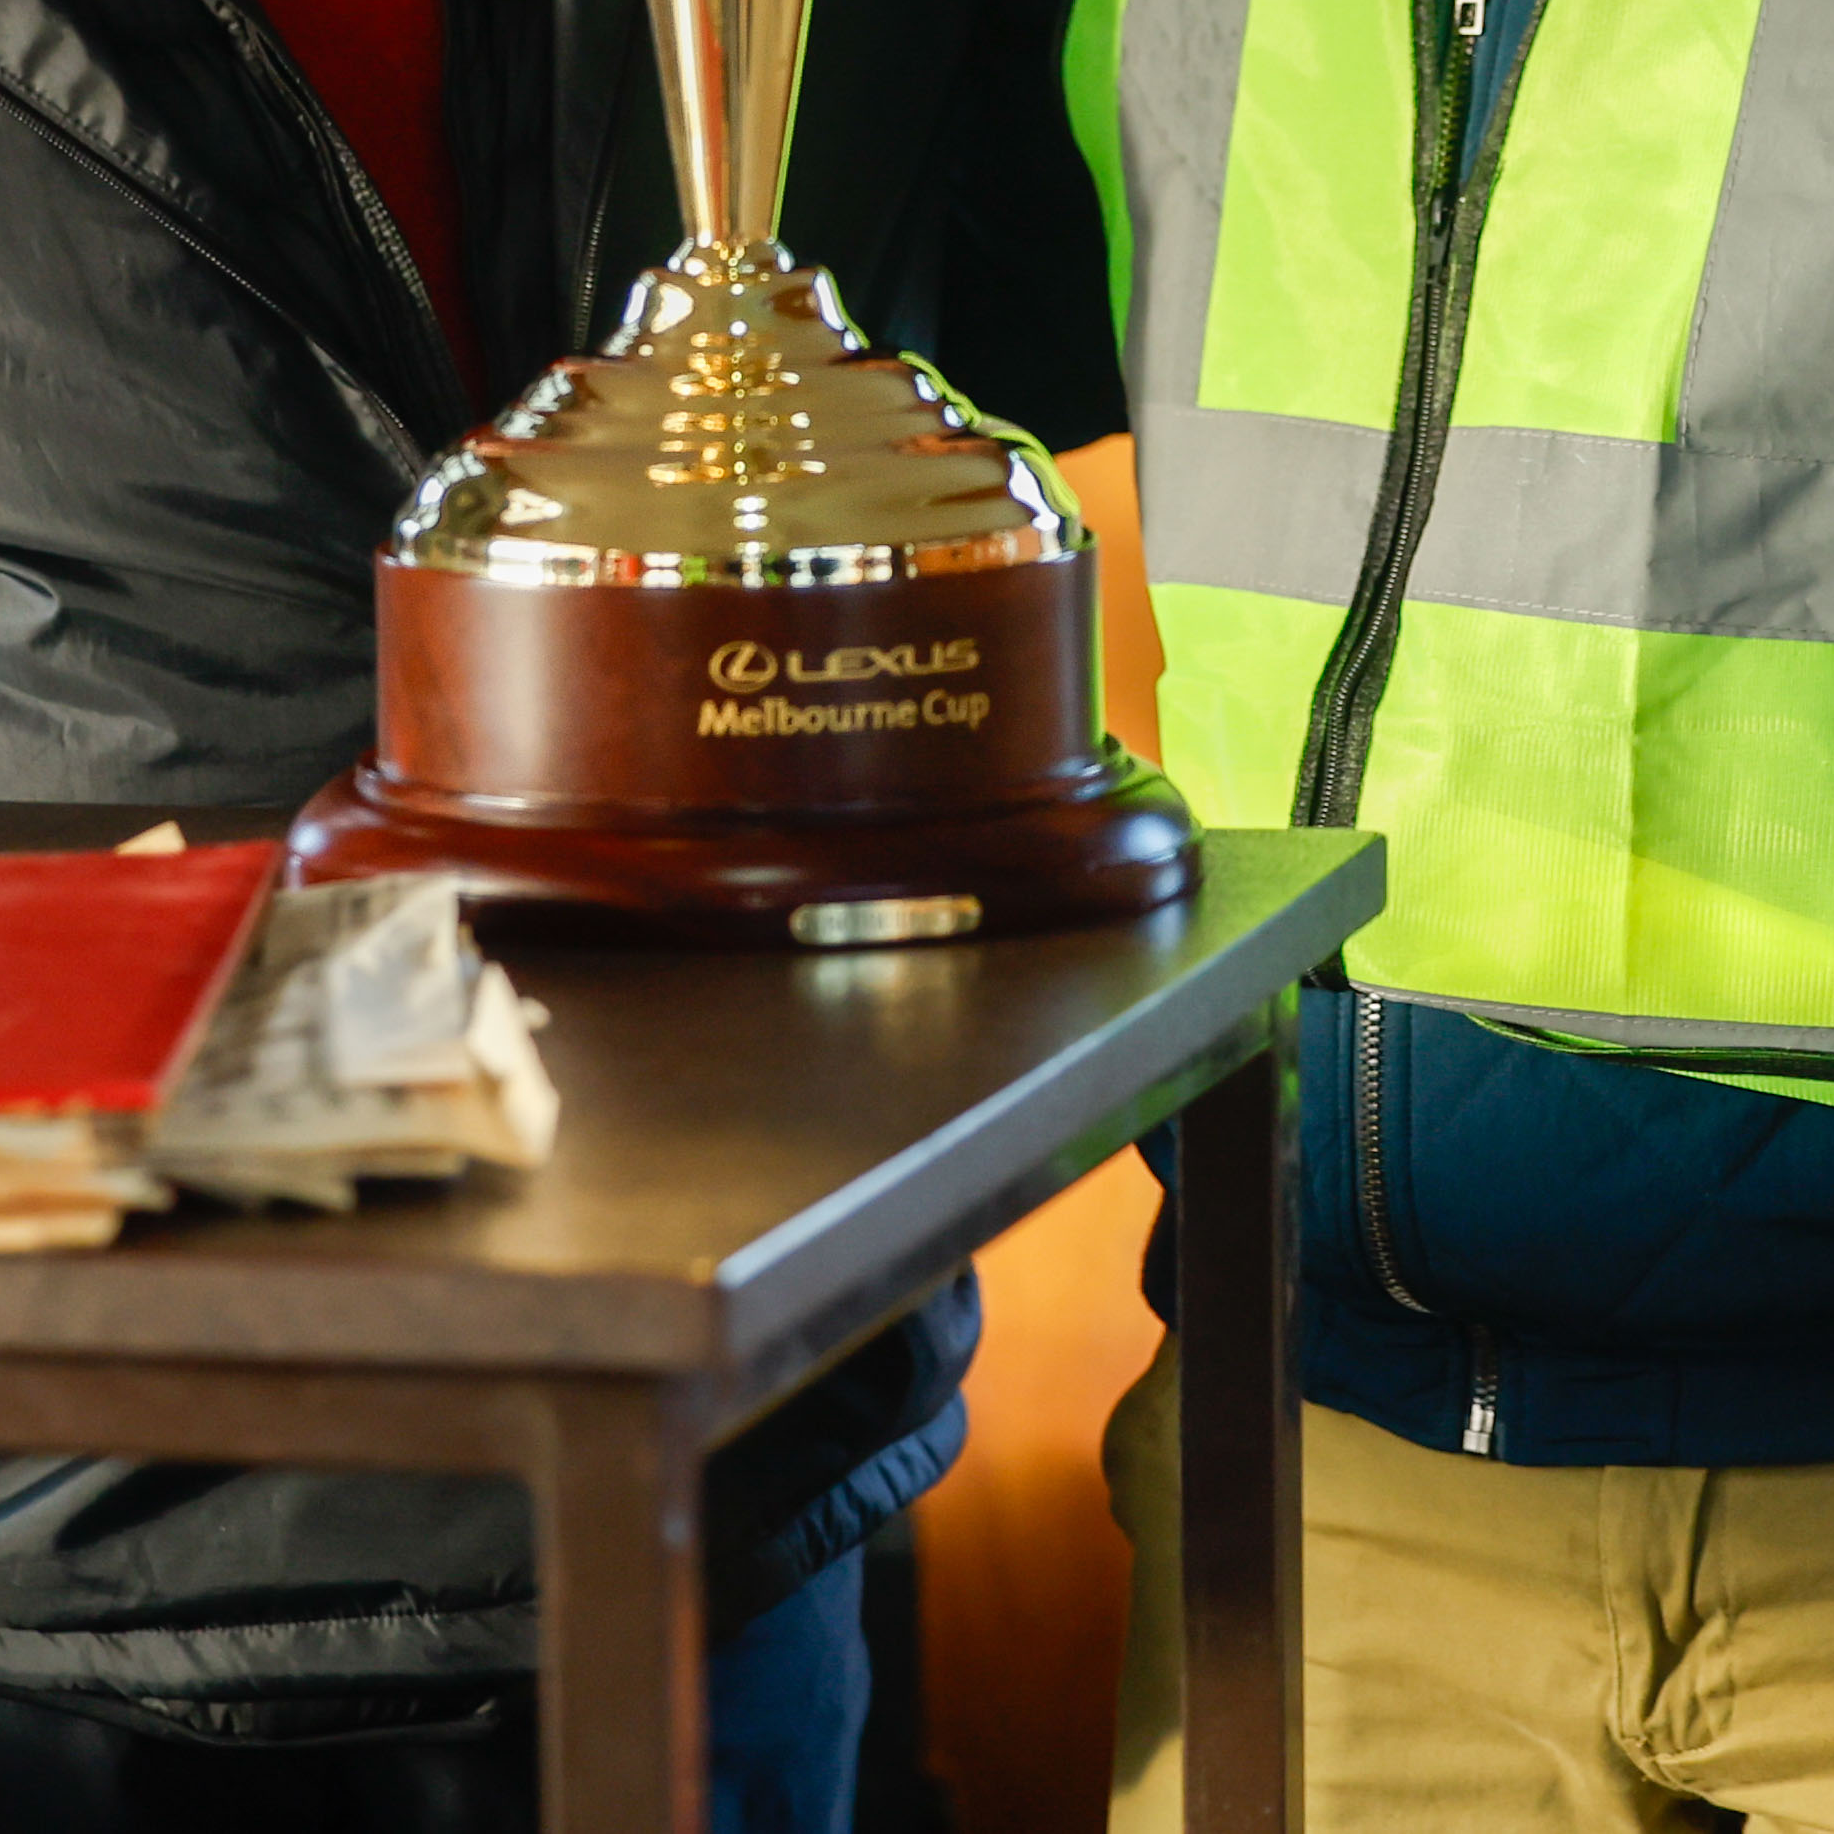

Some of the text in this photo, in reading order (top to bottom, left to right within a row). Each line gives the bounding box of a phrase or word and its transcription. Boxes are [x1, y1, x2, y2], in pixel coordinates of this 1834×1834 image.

[785, 638, 981, 684] LEXUS
[697, 688, 991, 737] Melbourne Cup
